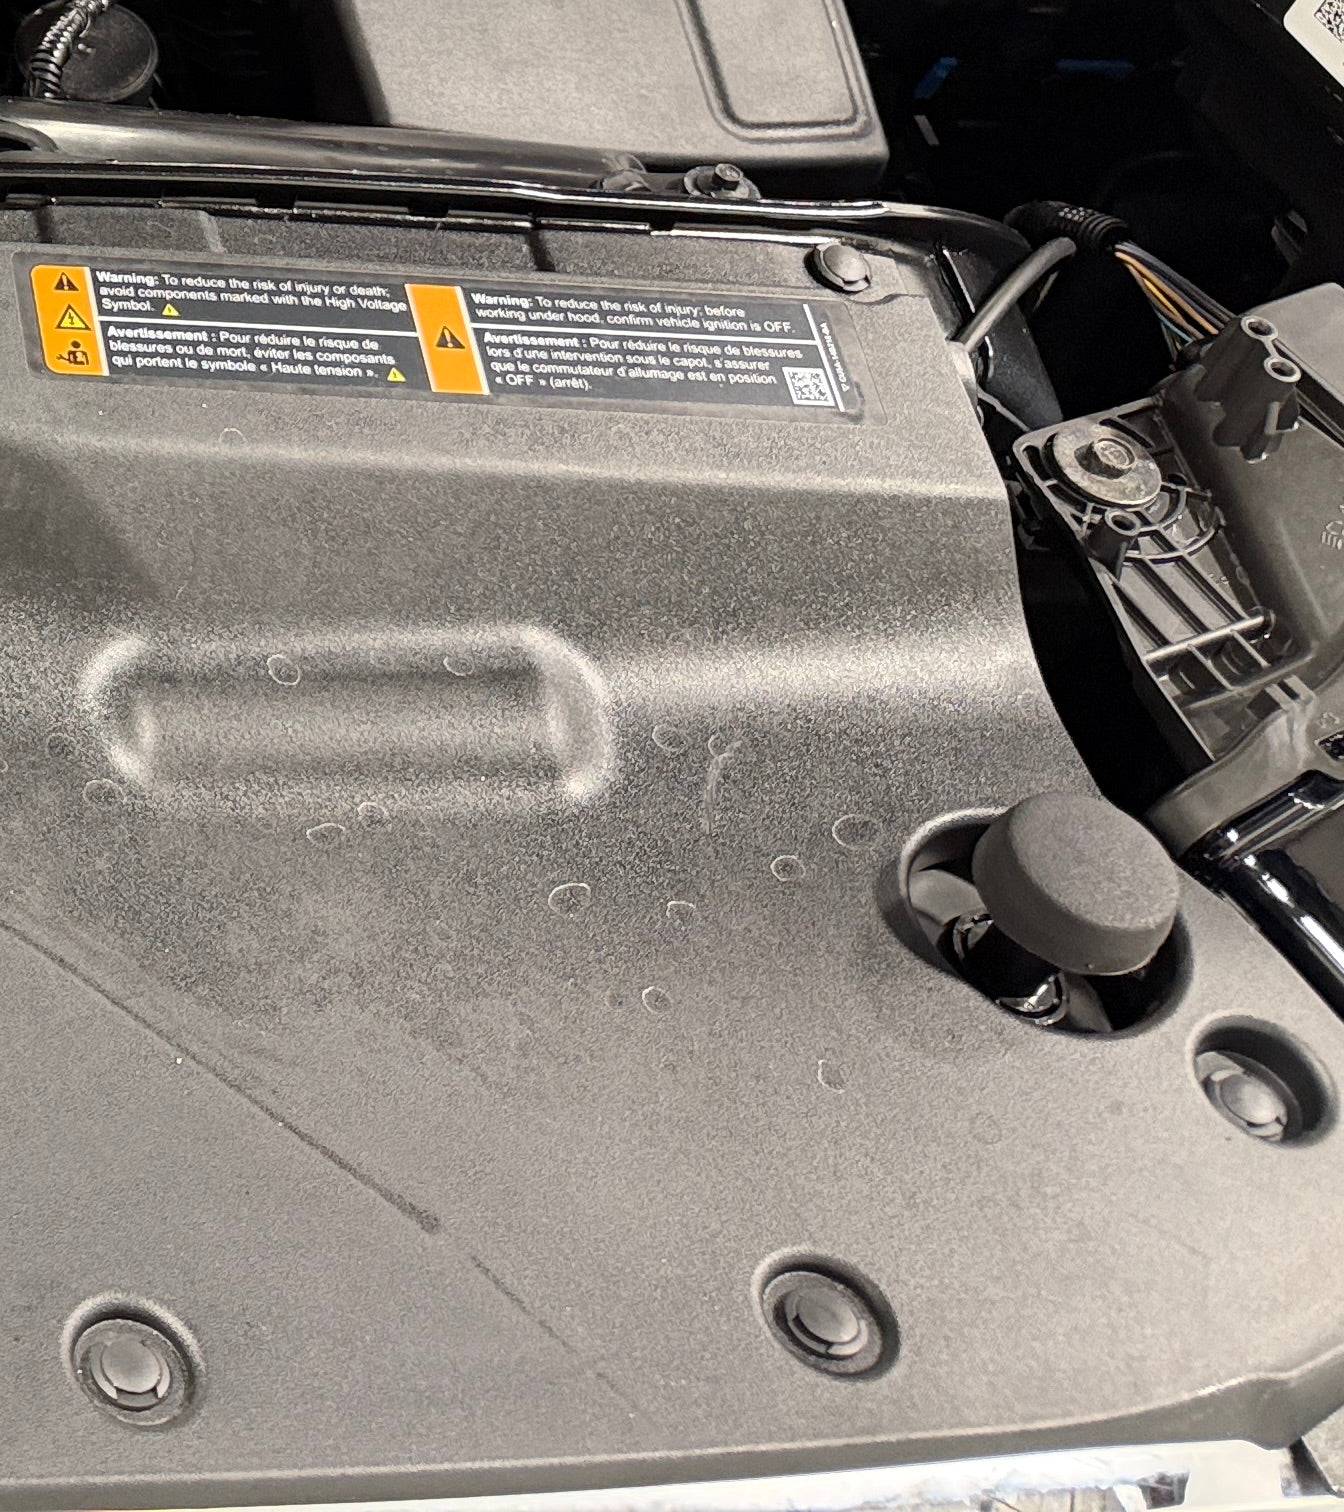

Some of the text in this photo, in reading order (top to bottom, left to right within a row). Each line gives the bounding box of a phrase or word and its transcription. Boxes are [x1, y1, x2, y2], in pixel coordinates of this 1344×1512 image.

[96, 271, 159, 286] Warning:
[161, 274, 178, 285] To
[181, 276, 226, 288] reduce
[229, 278, 249, 289] the
[253, 280, 277, 290] risk
[279, 280, 291, 291] of
[294, 281, 329, 295] injury
[333, 285, 346, 294] or
[100, 286, 407, 312] avoid components marked with the High Voltage
[102, 298, 155, 312] Symbol.
[471, 293, 533, 309] Warning:
[535, 296, 552, 307] To
[554, 299, 598, 310] reduce
[600, 300, 621, 311] the
[624, 301, 647, 312] risk
[649, 302, 662, 313] of
[704, 305, 745, 318] before
[475, 308, 526, 322] working
[528, 310, 565, 321] under
[606, 314, 654, 326] confirm
[655, 316, 700, 328] vehicle
[701, 318, 748, 331] ignition
[749, 320, 761, 332] is
[763, 321, 796, 333] OFF.
[107, 325, 208, 341] Avertissement
[219, 331, 251, 343] Pour
[254, 333, 300, 346] réduire
[303, 336, 316, 347] le
[318, 336, 359, 350] risque
[362, 339, 379, 350] de
[484, 331, 580, 347] Avertissement
[589, 337, 619, 349] Pour
[622, 339, 666, 352] réduire
[668, 341, 681, 352] le
[683, 342, 722, 356] risque
[724, 344, 740, 356] de
[742, 345, 803, 359] blessures
[109, 340, 396, 365] blessures ou de mort, éviter les composants
[486, 346, 511, 357] lors
[550, 349, 624, 363] intervention
[626, 355, 656, 367] sous
[657, 354, 670, 365] le
[673, 357, 712, 369] capot,
[112, 354, 133, 367] qui
[136, 356, 183, 368] portent
[185, 357, 198, 369] le
[201, 359, 257, 372] symbole
[271, 362, 311, 374] Haute
[314, 364, 362, 377] tension
[490, 362, 515, 373] que
[517, 361, 530, 372] le
[532, 363, 613, 376] commutateur
[687, 370, 708, 381] est
[709, 372, 726, 382] en
[728, 372, 778, 384] position
[505, 373, 534, 386] OFF
